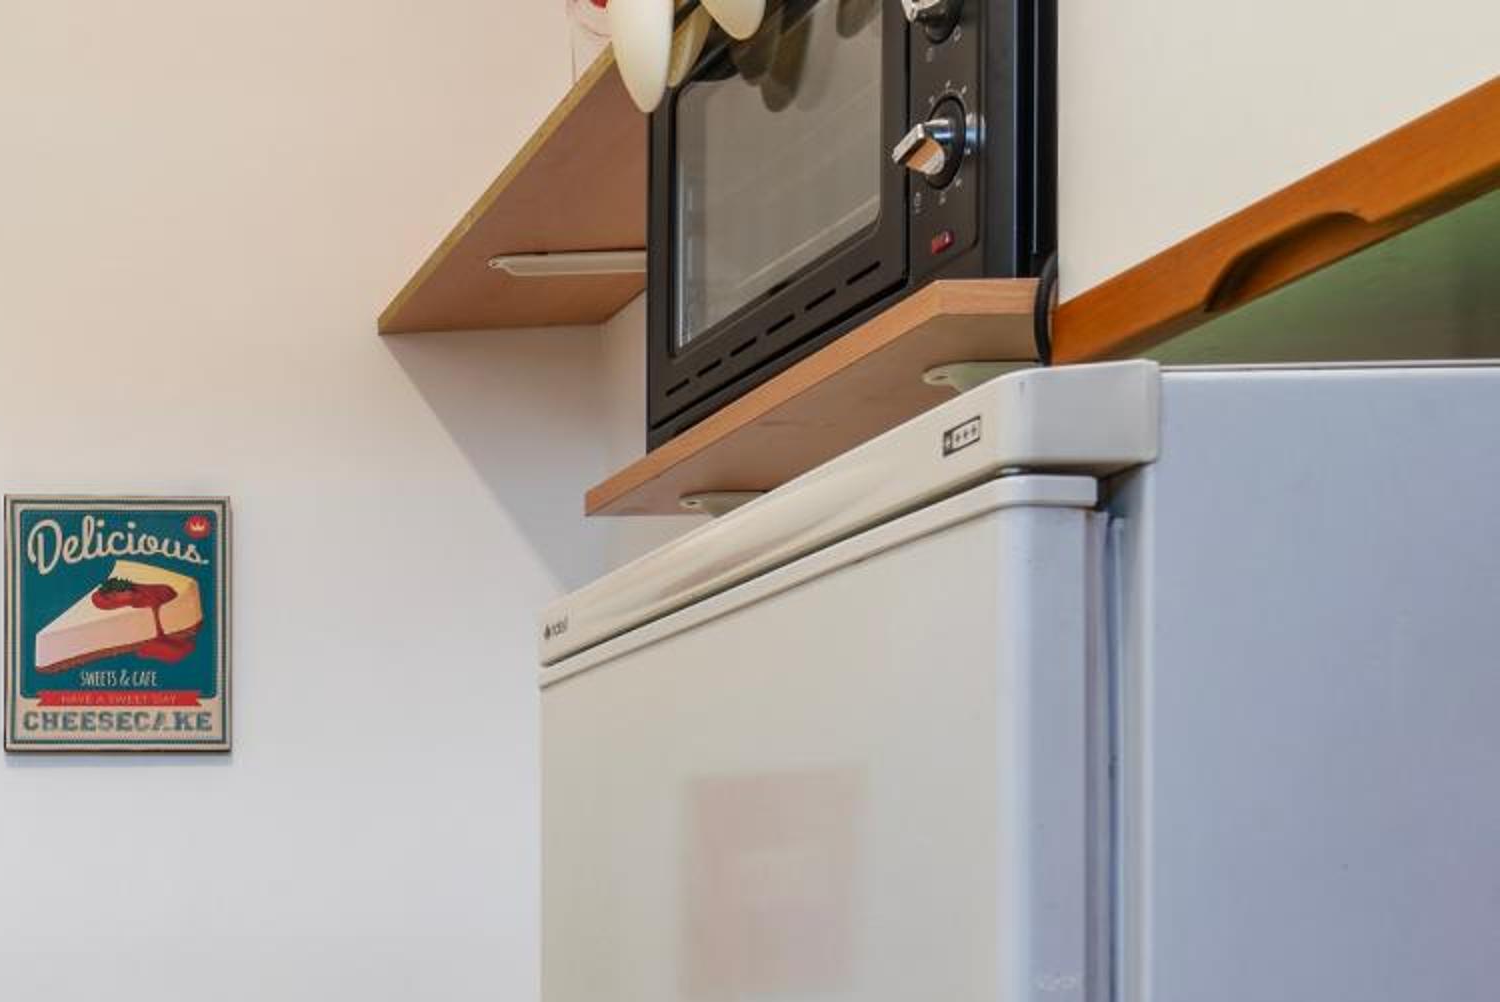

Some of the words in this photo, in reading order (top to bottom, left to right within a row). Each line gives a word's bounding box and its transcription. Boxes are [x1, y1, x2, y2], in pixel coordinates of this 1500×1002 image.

[27, 515, 209, 575] Delicious
[80, 671, 117, 688] SWEETS
[119, 668, 131, 688] &
[23, 711, 213, 731] CHEESECAKE
